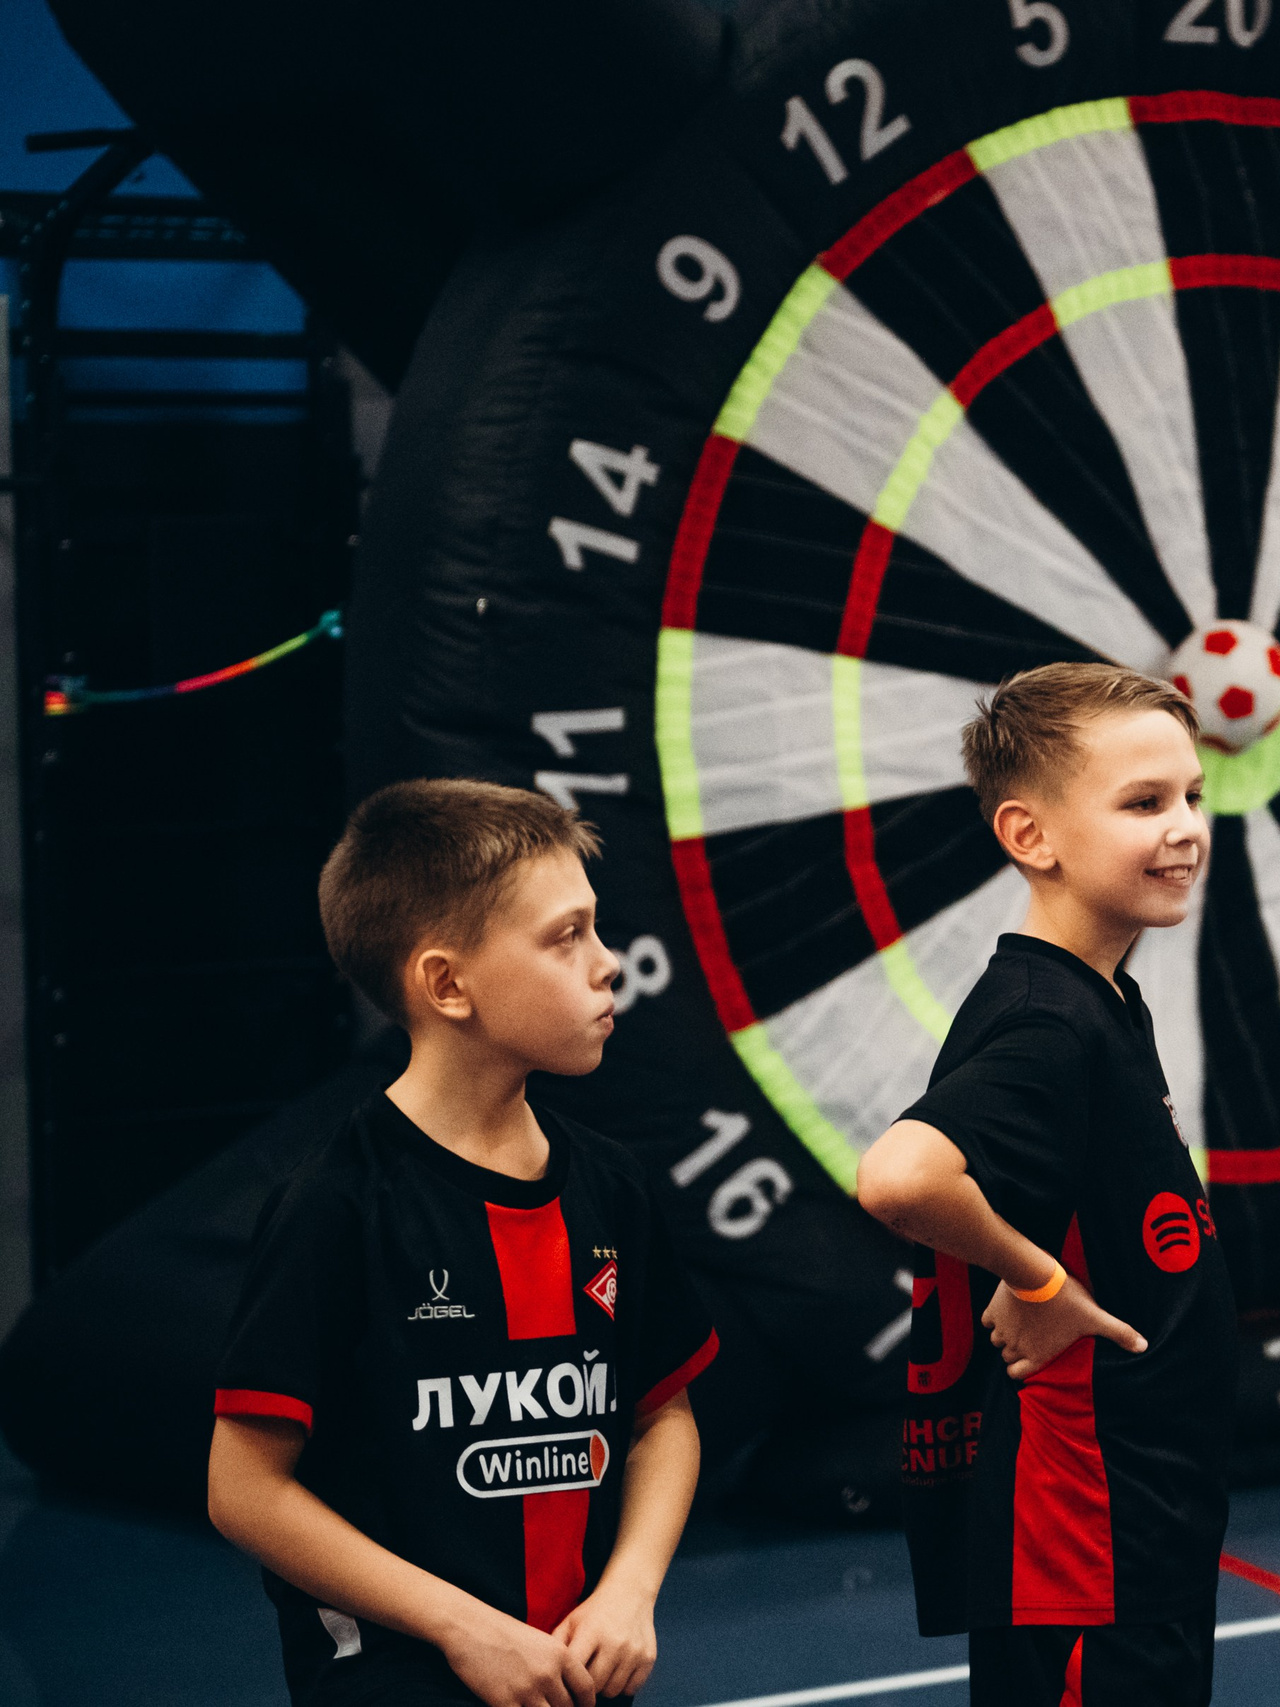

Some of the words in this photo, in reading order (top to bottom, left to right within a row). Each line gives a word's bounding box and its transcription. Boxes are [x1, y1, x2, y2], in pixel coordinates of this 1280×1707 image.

[1008, 0, 1071, 67] 5
[780, 57, 911, 185] 12
[656, 233, 742, 322] 9
[547, 437, 662, 572] 14
[611, 934, 673, 1016] 8
[671, 1108, 794, 1240] 16
[407, 1303, 476, 1321] JÖGEL
[411, 1349, 618, 1431] ЛУКОЙ
[478, 1446, 590, 1484] Winline
